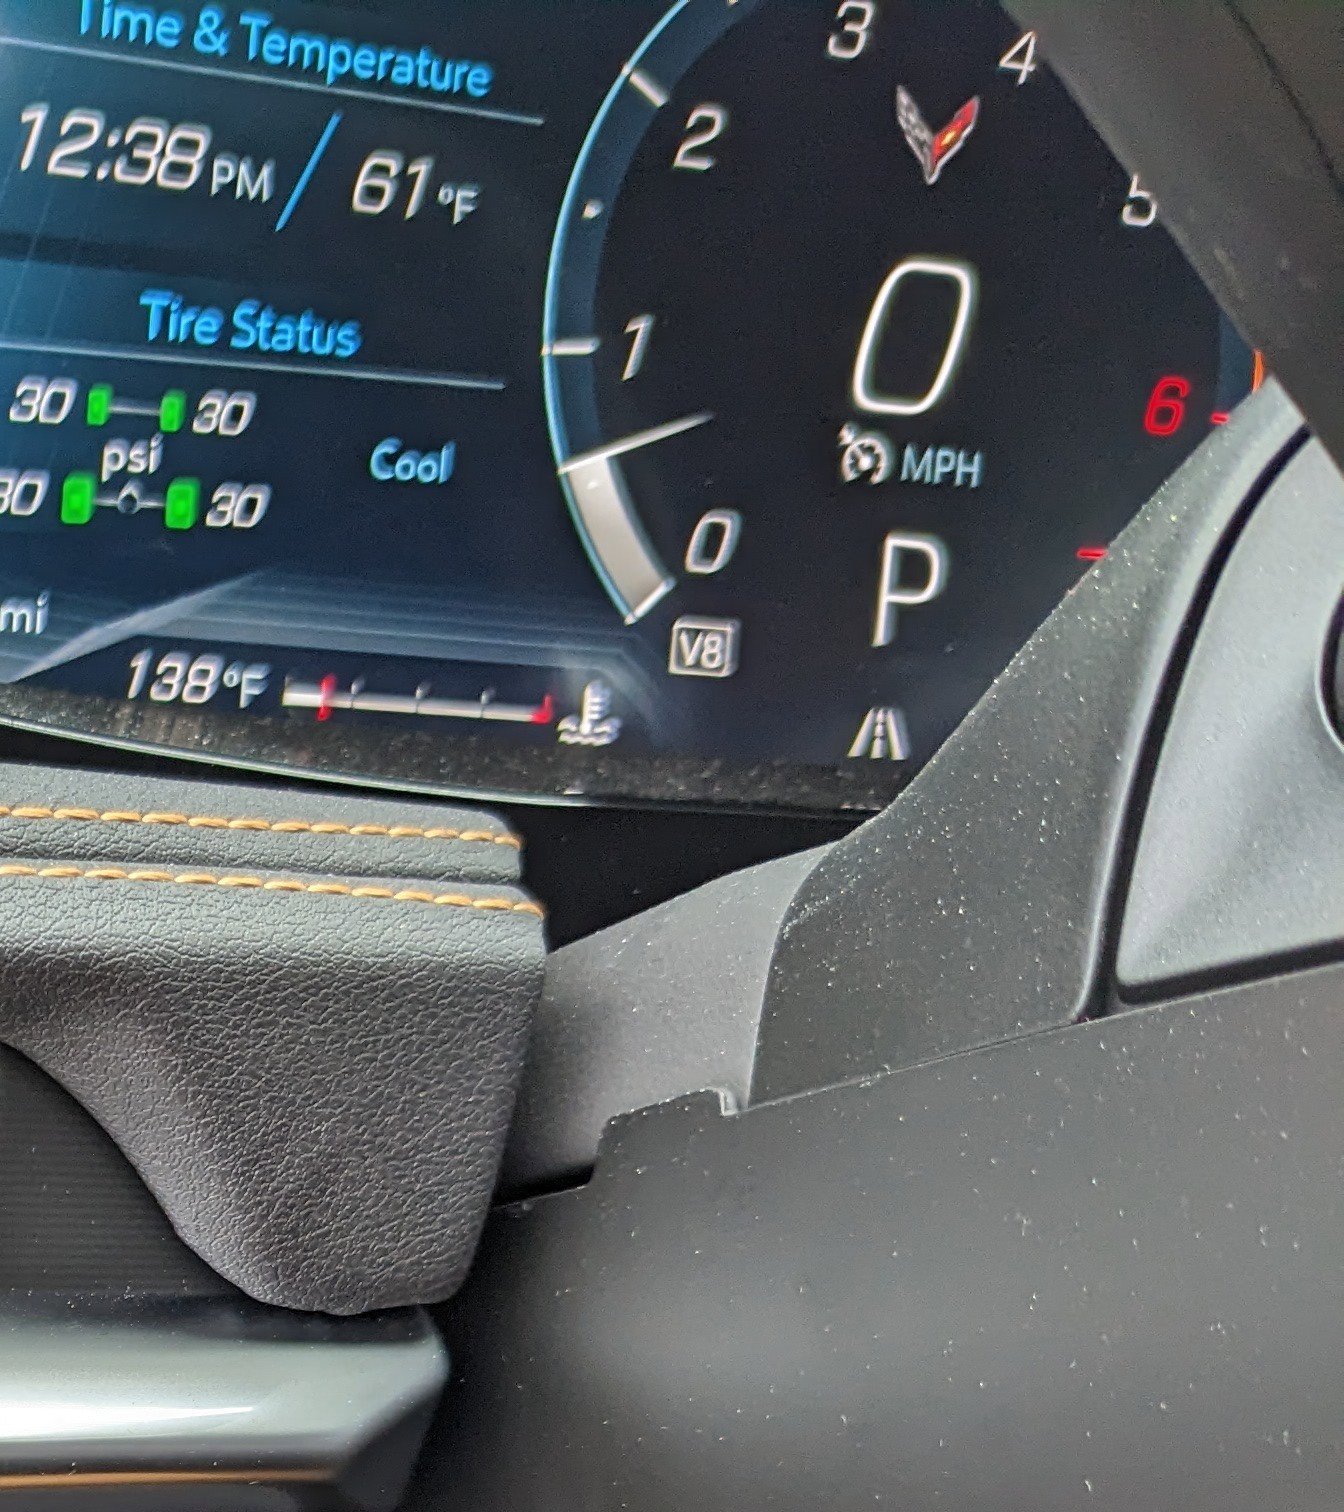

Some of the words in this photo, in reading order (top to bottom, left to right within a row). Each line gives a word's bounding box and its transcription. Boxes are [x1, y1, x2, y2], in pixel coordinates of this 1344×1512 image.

[78, 0, 185, 49] Time
[192, 2, 229, 57] &
[239, 9, 495, 98] Temperature
[827, 0, 876, 60] 3
[998, 30, 1038, 86] 4
[672, 102, 728, 172] 2
[139, 288, 226, 345] Tire
[229, 297, 363, 358] Status
[621, 313, 656, 383] 1
[852, 254, 978, 416] 0
[8, 374, 79, 425] 30
[191, 389, 258, 437] 30
[1143, 375, 1191, 438] 6
[100, 431, 164, 483] psi
[369, 437, 457, 485] Cool
[900, 445, 983, 489] MPH
[204, 481, 273, 529] 30
[684, 508, 743, 575] 0
[871, 530, 948, 648] P
[679, 630, 725, 670] V8
